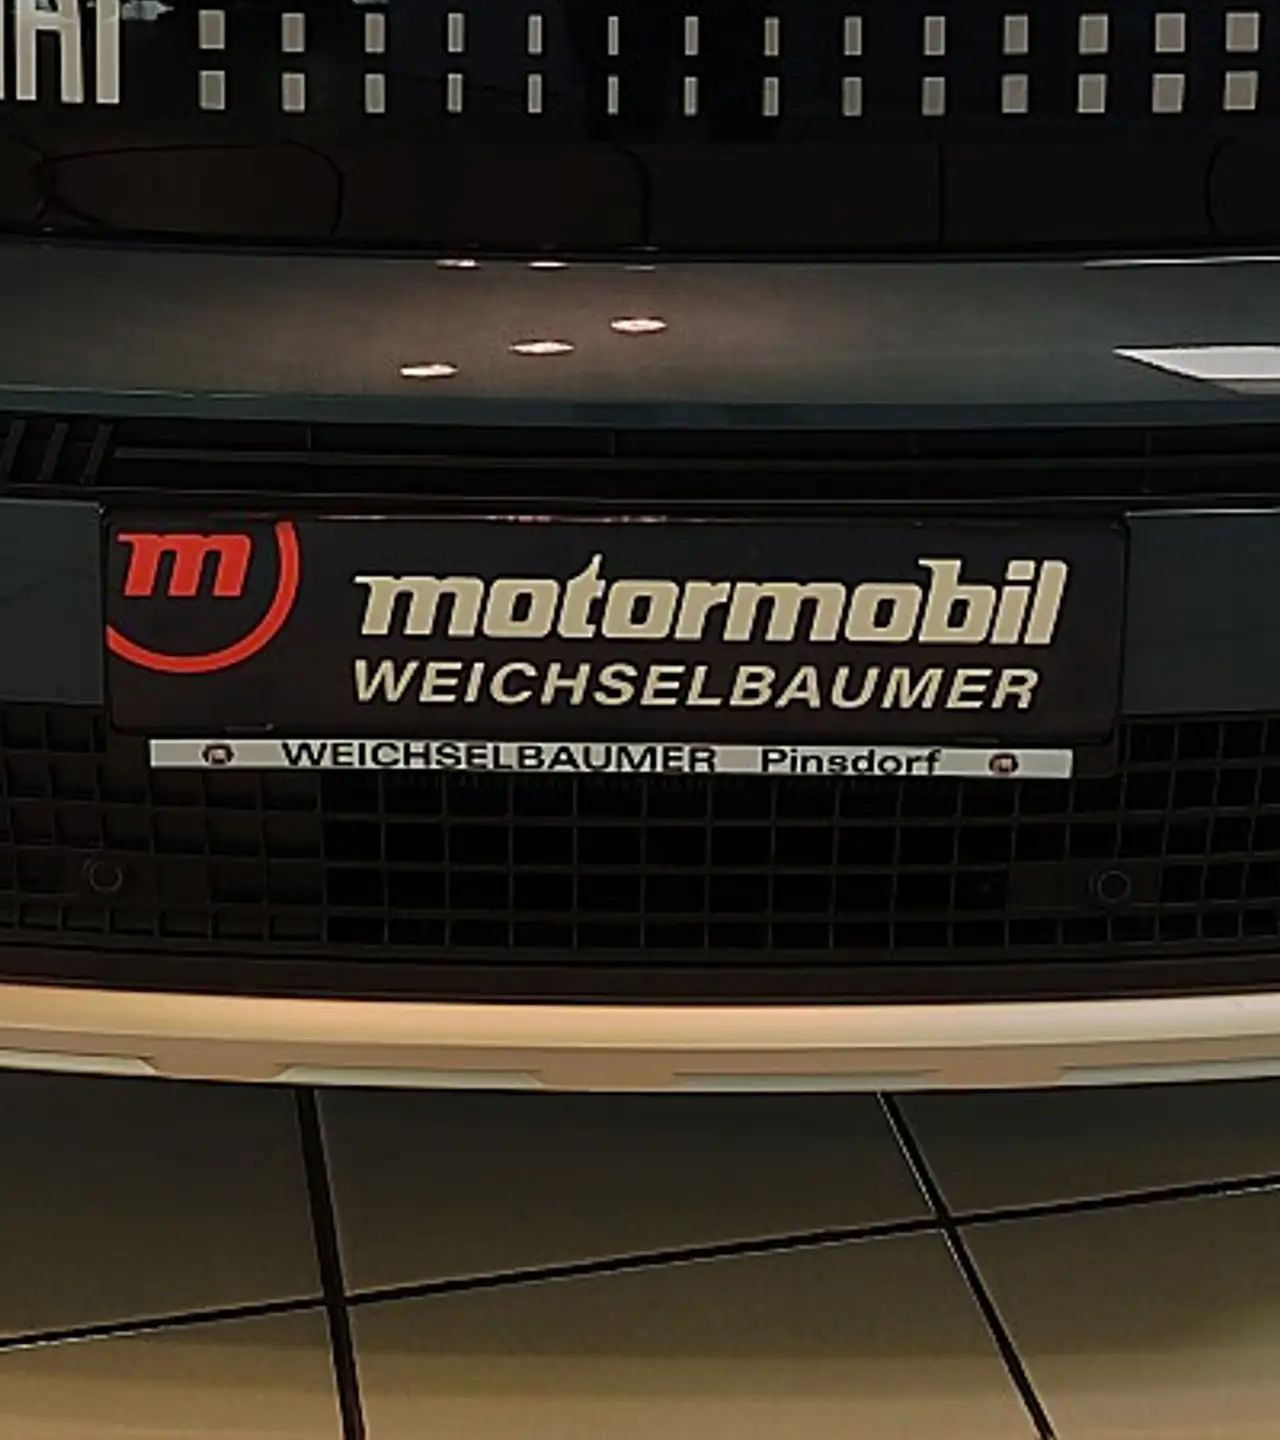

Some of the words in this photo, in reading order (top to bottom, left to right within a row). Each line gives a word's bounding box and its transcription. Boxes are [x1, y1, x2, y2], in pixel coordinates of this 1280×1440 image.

[353, 553, 1068, 645] motormobil
[354, 658, 1039, 709] WEICHSELBAUMER
[283, 741, 717, 773] WEICHSELBAUMER
[760, 748, 942, 776] Pinsdorf
